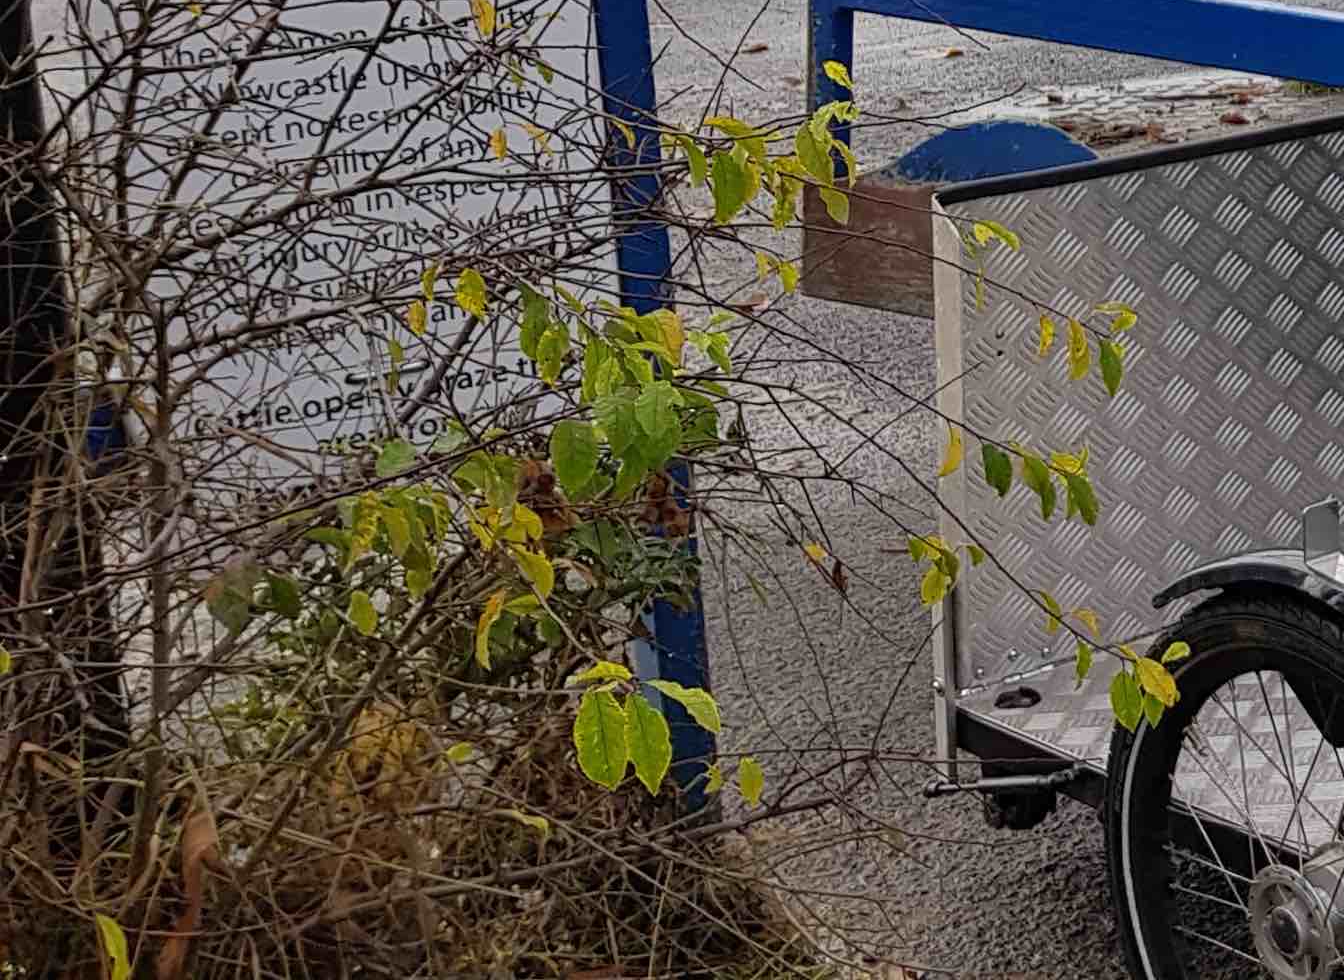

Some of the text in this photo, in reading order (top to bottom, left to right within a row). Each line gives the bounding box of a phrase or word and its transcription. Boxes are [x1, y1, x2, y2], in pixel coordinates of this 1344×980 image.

[285, 119, 326, 140] no
[400, 133, 431, 165] of
[366, 190, 393, 212] in
[434, 364, 509, 394] raze
